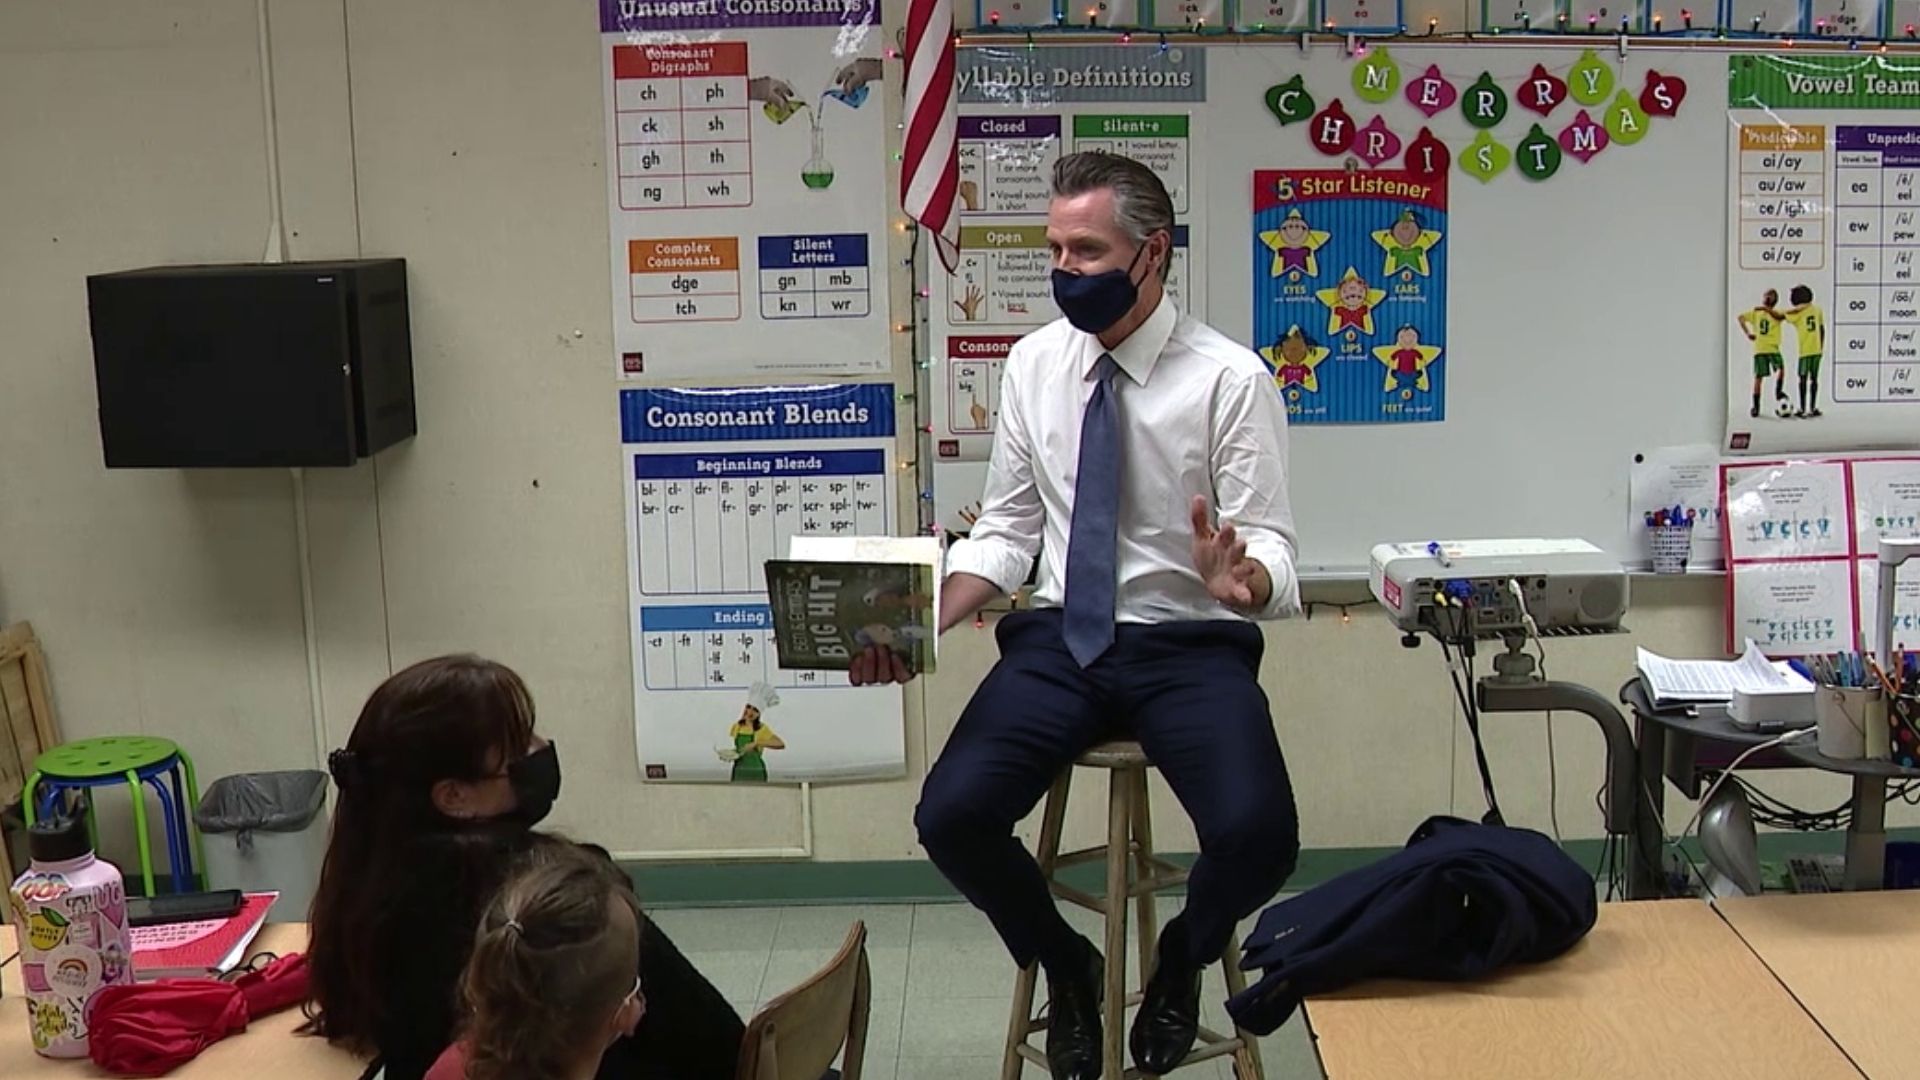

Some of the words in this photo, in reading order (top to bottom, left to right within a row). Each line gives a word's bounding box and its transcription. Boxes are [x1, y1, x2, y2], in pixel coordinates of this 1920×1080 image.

[620, 0, 718, 19] Unusual
[726, 0, 862, 15] Consonants
[651, 60, 710, 75] Digraphs
[957, 65, 1046, 94] yllable
[1053, 65, 1192, 88] Definitions
[1788, 73, 1854, 94] Vowel
[1864, 73, 1920, 93] Team
[639, 85, 657, 101] ch
[705, 84, 725, 102] ph
[641, 117, 659, 133] ck
[708, 115, 725, 131] sh
[981, 120, 1027, 133] Closed
[1103, 119, 1160, 133] Silent-e
[1867, 131, 1920, 147] Unpredic
[642, 150, 660, 168] gh
[709, 149, 725, 164] th
[707, 181, 730, 196] wh
[1277, 177, 1294, 200] 5
[1302, 175, 1344, 195] Star
[1350, 175, 1431, 200] Listener
[1758, 176, 1806, 192] au/aw
[1851, 183, 1868, 193] ea
[643, 187, 662, 201] ng
[1760, 223, 1804, 240] oa/oe
[1849, 221, 1869, 232] ew
[793, 238, 834, 251] Silent
[986, 231, 1022, 245] Open
[655, 242, 711, 257] Complex
[647, 256, 721, 268] Consonants
[791, 251, 835, 264] Letters
[671, 275, 698, 292] dge
[778, 276, 796, 290] gn
[829, 273, 852, 286] mb
[675, 301, 697, 315] tch
[779, 299, 797, 312] kn
[831, 299, 852, 311] wr
[1849, 300, 1866, 310] oo
[1889, 309, 1917, 318] moon
[1759, 318, 1770, 335] 9
[1806, 315, 1816, 332] 5
[959, 341, 1012, 353] Conson
[1888, 346, 1917, 356] house
[1846, 378, 1867, 388] ow
[647, 405, 776, 428] Consonant
[784, 402, 869, 425] Blends
[697, 459, 771, 475] Beginning
[775, 457, 823, 470] Blends
[641, 482, 657, 496] bl-
[668, 482, 682, 495] cl-
[694, 482, 712, 495] dr-
[748, 482, 764, 497] gl-
[775, 482, 791, 497] pl-
[802, 483, 818, 493] sc-
[829, 482, 848, 497] sp-
[855, 481, 871, 492] tr-
[641, 501, 660, 514] br-
[668, 503, 685, 514] cr-
[721, 501, 737, 513] fr-
[748, 502, 767, 517] gr-
[775, 502, 793, 516] pr-
[803, 502, 824, 513] scr-
[829, 500, 851, 516] spl-
[856, 500, 878, 511] tw-
[804, 519, 821, 531] sk-
[829, 519, 854, 534] spr-
[807, 575, 843, 617] HIT
[714, 610, 766, 627] Ending
[648, 636, 663, 647] -ct
[677, 634, 691, 647] -ft
[707, 633, 723, 646] -ld
[737, 634, 753, 649] -lp
[808, 624, 850, 659] BIG
[738, 651, 751, 664] -lt
[709, 669, 724, 683] -lk
[798, 671, 815, 682] -nt
